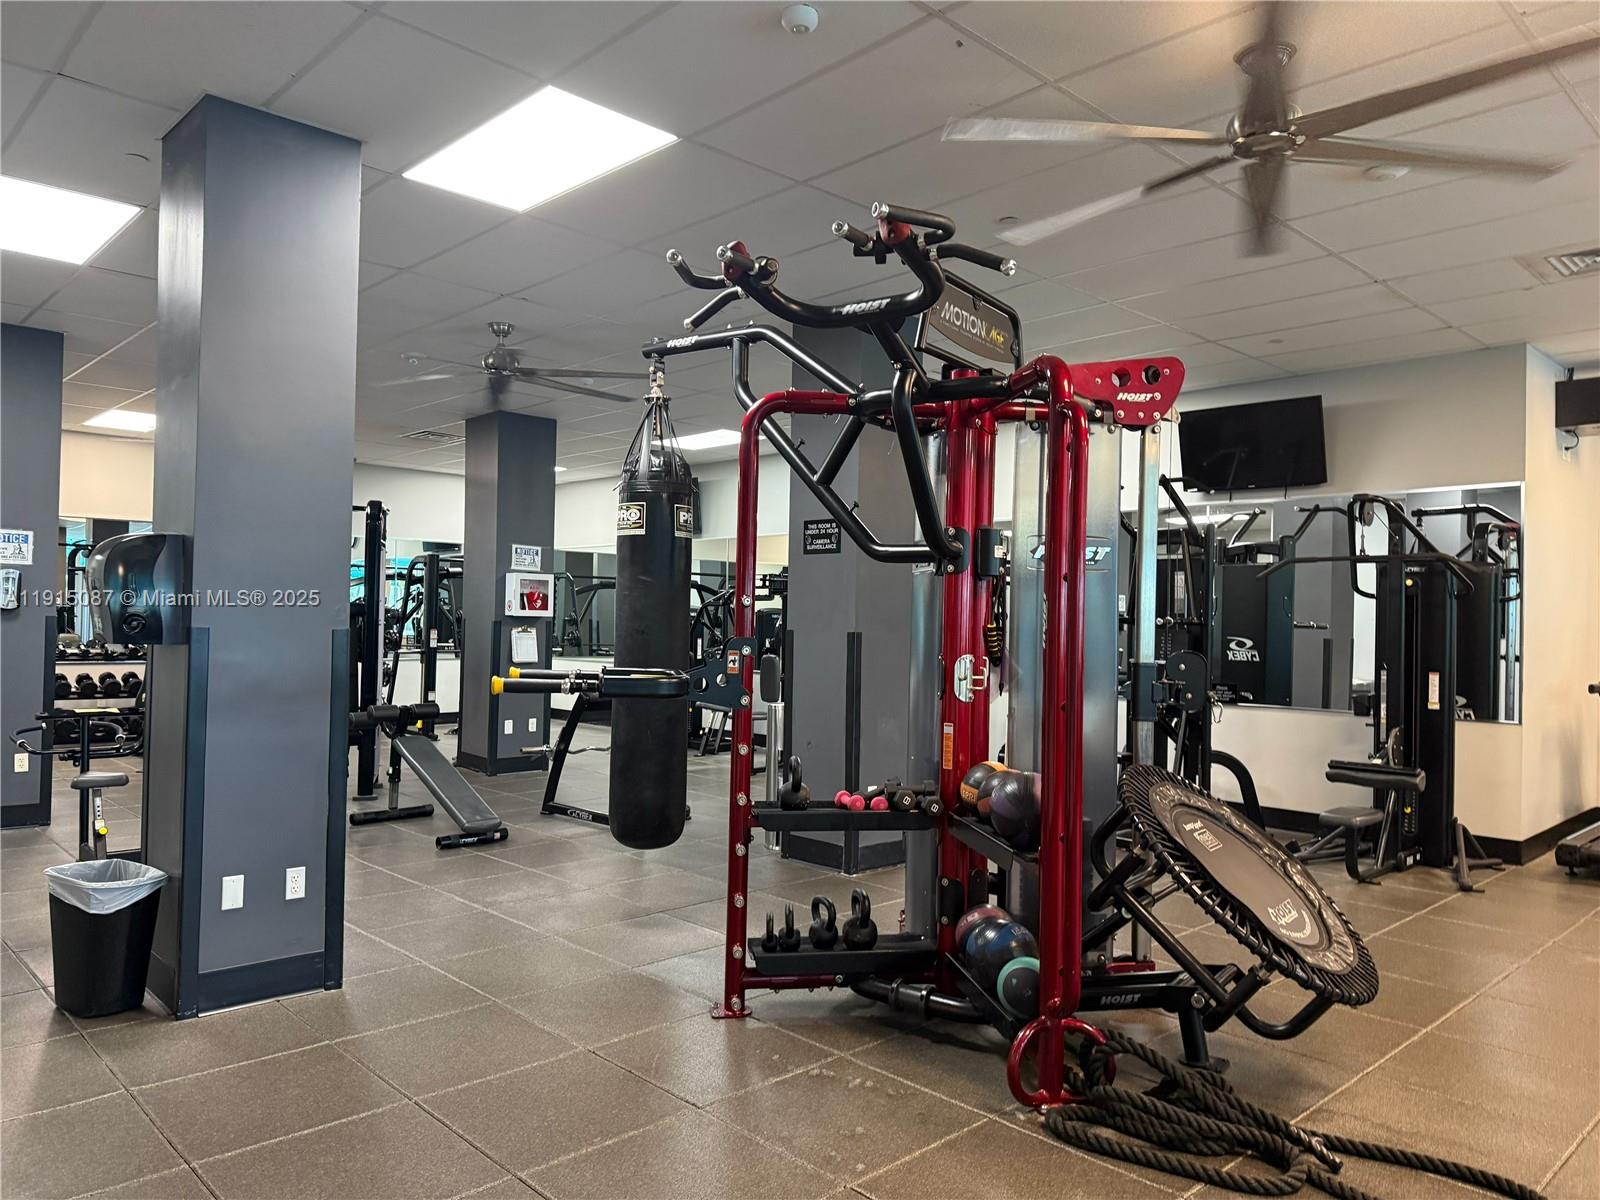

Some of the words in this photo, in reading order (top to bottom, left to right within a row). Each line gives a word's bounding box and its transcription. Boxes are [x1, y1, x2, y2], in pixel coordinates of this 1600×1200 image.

[842, 298, 891, 315] HOIST
[667, 335, 698, 348] HOIST
[1117, 392, 1153, 401] HOIST
[903, 796, 911, 806] 8
[931, 803, 939, 813] 8
[1267, 898, 1298, 926] HOIST
[1100, 994, 1141, 1005] HOIST
